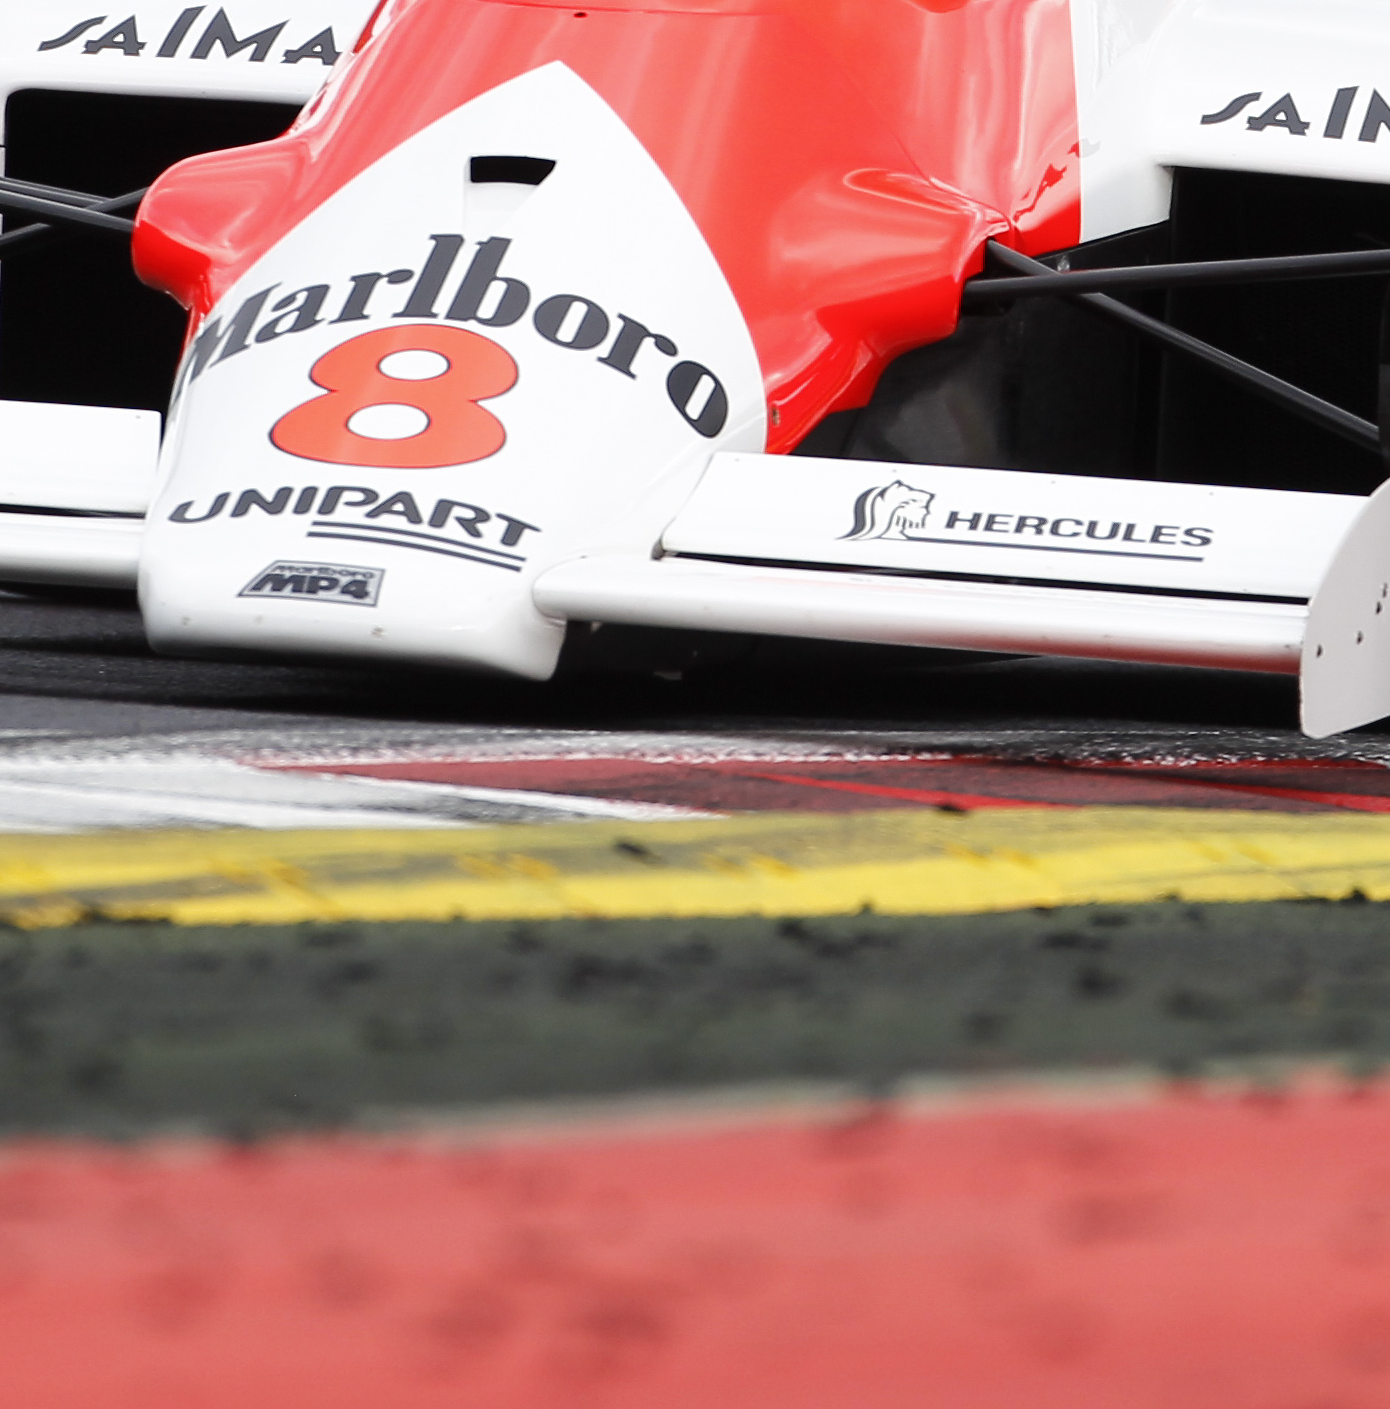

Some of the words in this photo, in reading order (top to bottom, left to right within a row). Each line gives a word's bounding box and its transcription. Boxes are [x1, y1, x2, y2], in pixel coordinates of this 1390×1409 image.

[38, 4, 344, 66] SAIMA
[173, 233, 729, 439] Marlboro
[270, 323, 519, 469] 8
[167, 486, 542, 548] UNIPART
[944, 510, 1215, 547] HERCULES
[251, 573, 370, 600] MP4
